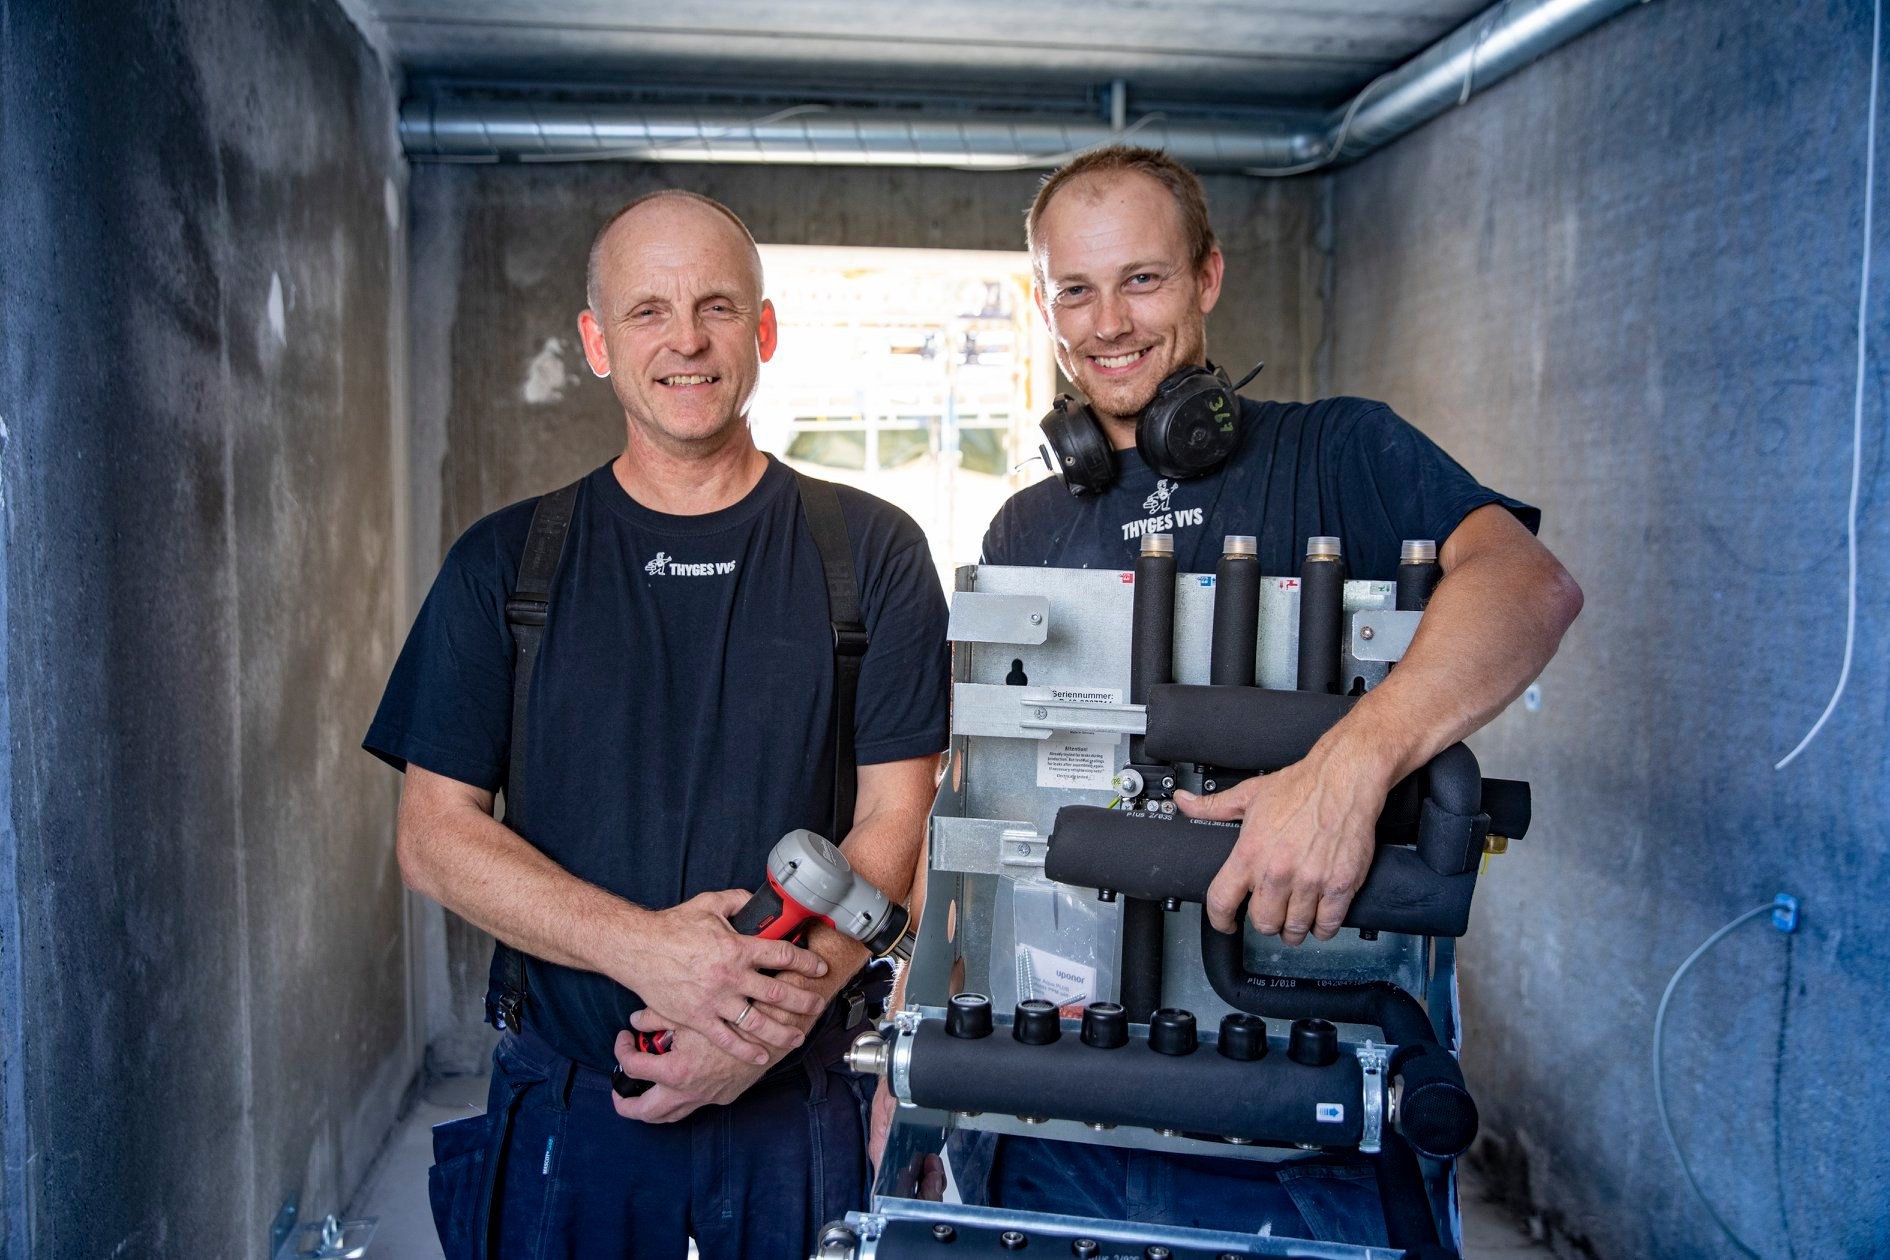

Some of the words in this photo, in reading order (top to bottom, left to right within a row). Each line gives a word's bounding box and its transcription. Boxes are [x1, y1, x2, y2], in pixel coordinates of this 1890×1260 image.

[1121, 513, 1174, 541] THYGES
[1174, 507, 1204, 528] VVS
[669, 562, 714, 577] THYGES
[715, 560, 736, 575] VVS
[1052, 689, 1114, 700] Seriennummer:
[1056, 969, 1086, 984] uponor
